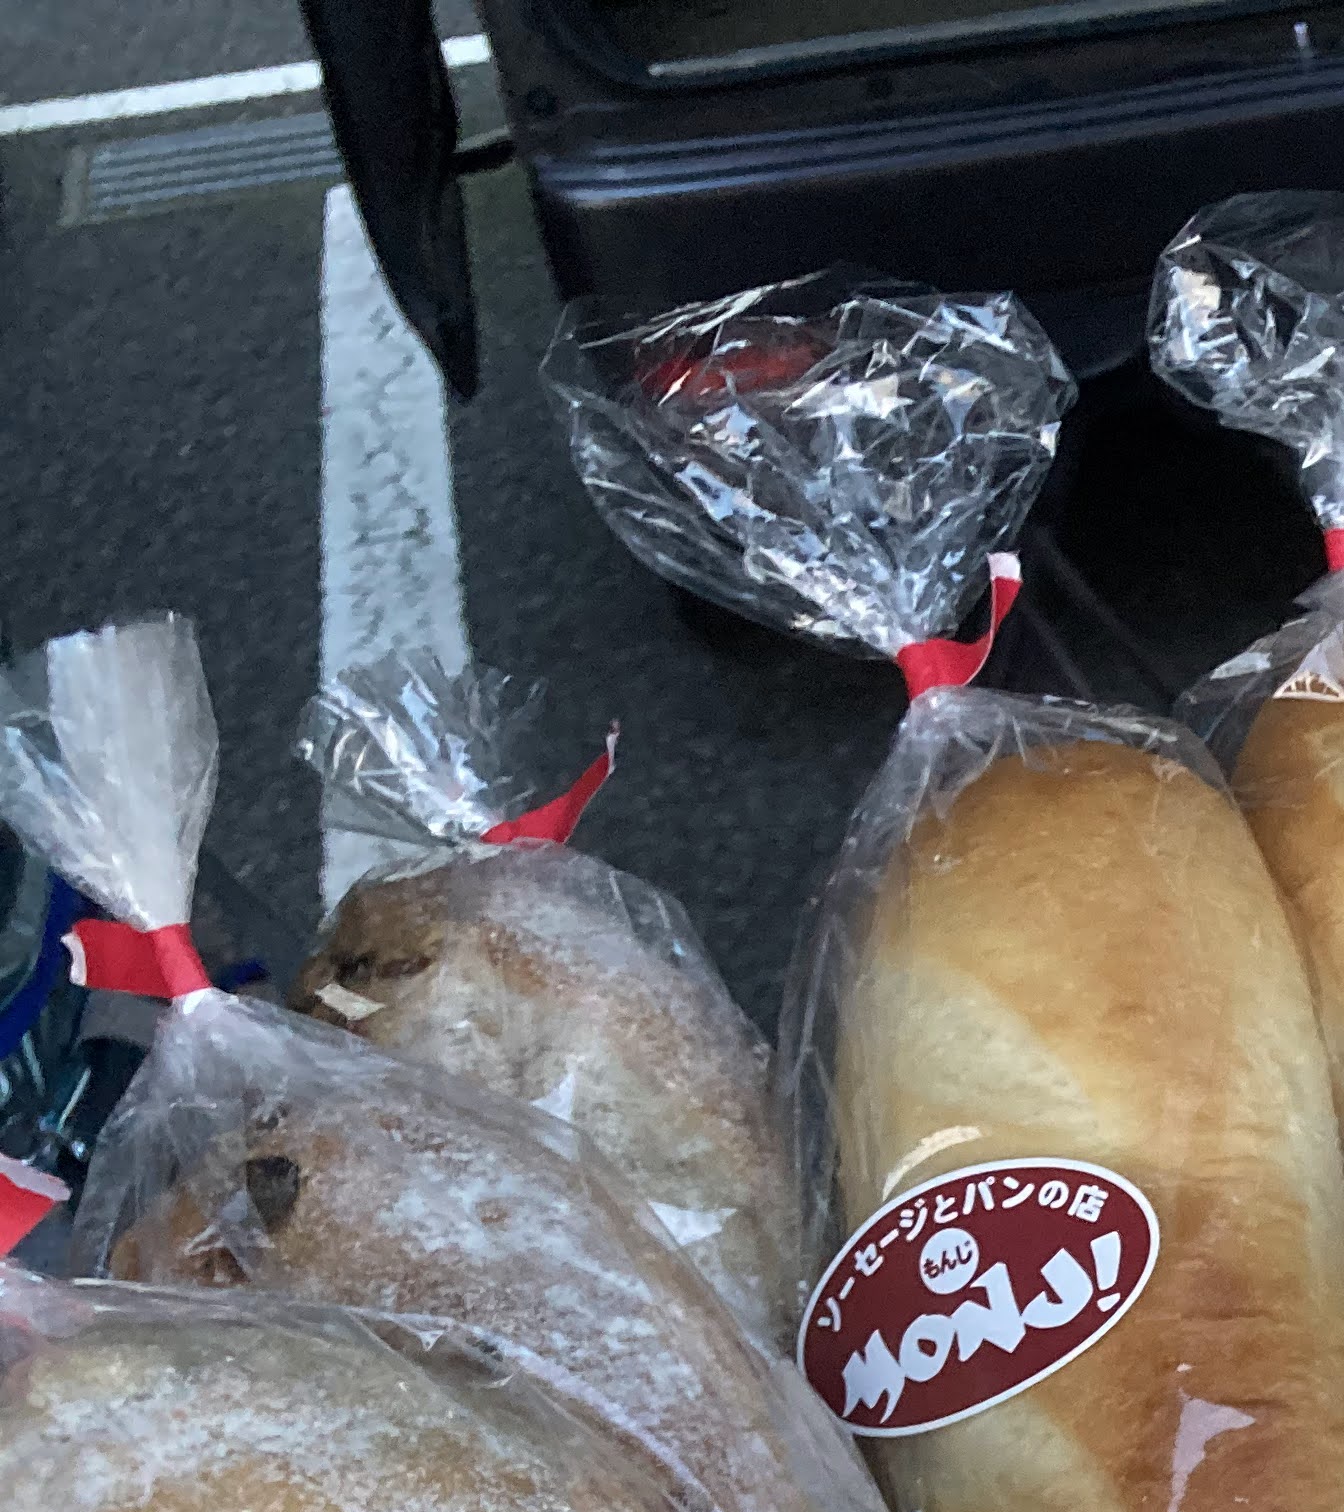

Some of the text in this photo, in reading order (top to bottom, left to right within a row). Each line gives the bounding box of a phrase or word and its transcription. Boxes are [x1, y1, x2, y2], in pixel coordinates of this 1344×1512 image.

[817, 1175, 1109, 1332] ソーセージとパンの店
[924, 1241, 971, 1279] もんじ
